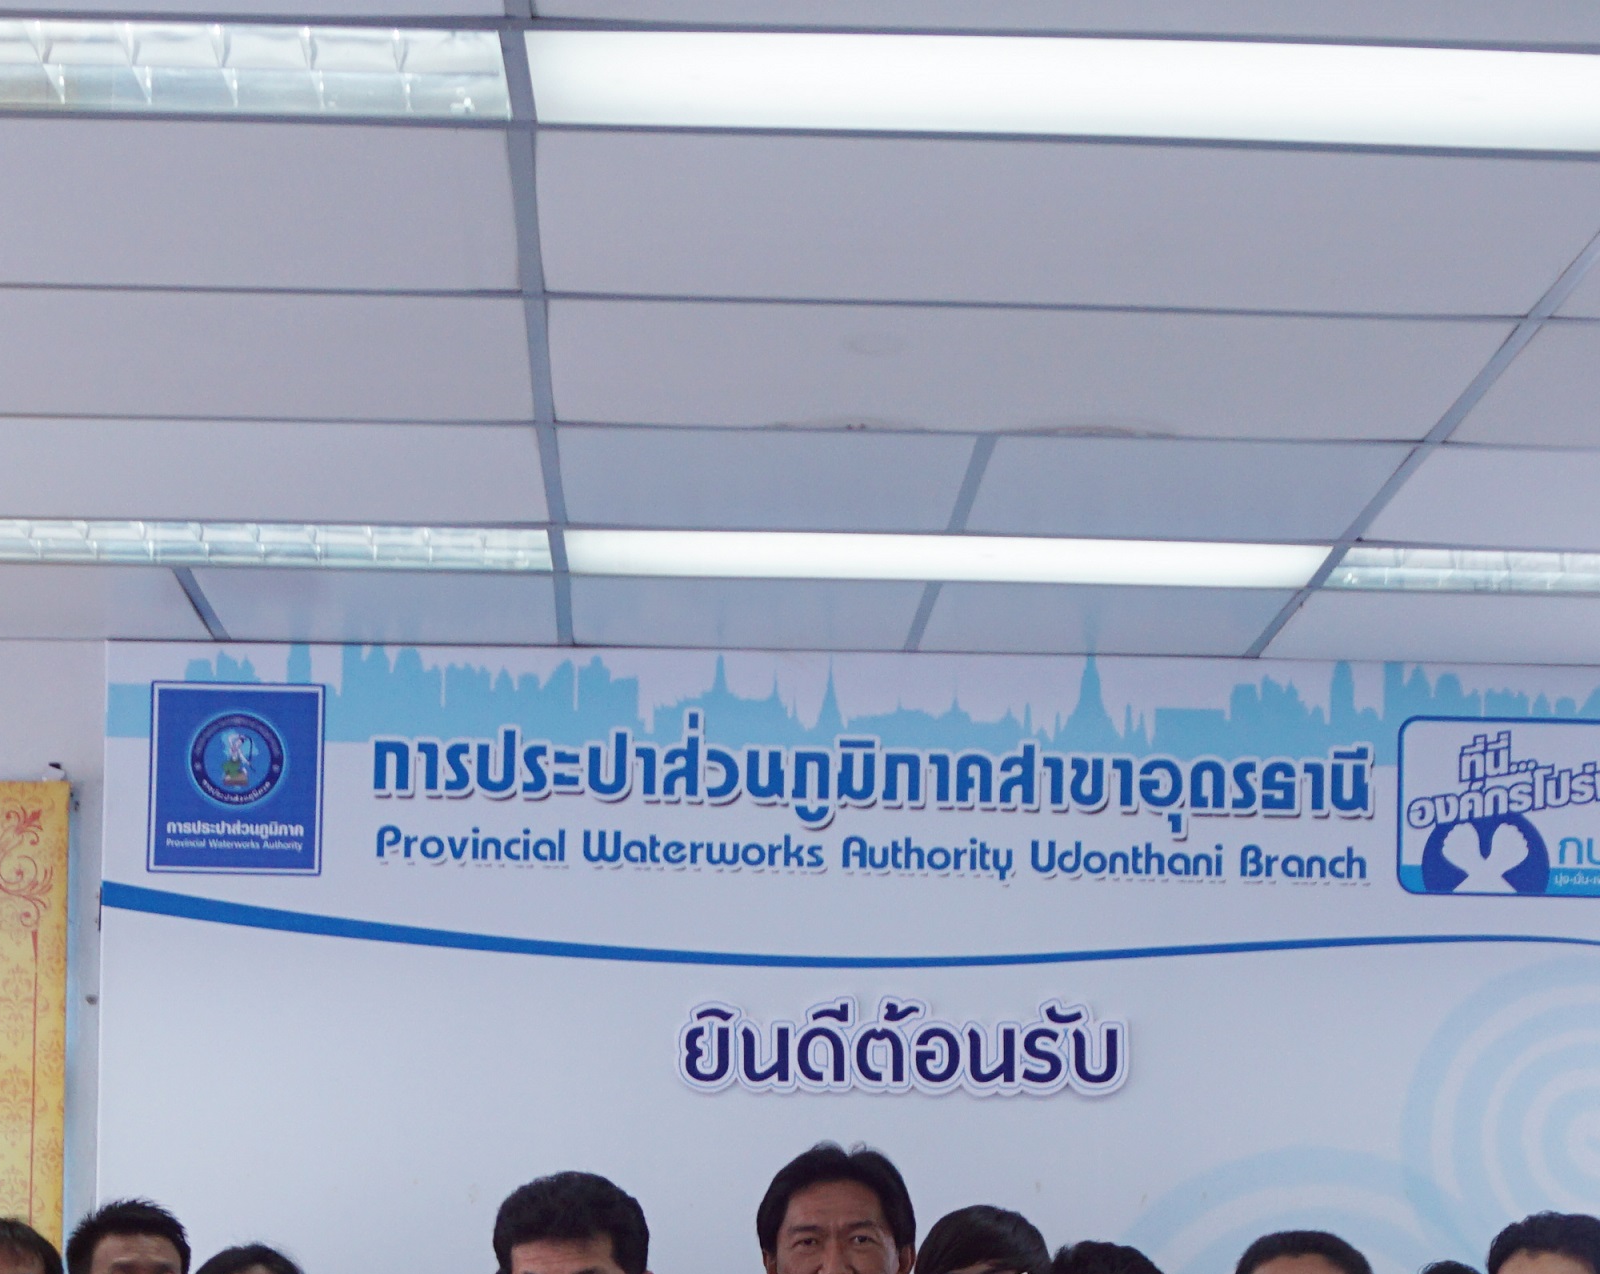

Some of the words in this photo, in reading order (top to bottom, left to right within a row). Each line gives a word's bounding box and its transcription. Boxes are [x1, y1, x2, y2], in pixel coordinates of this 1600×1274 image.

[373, 712, 1369, 832] การประปาส่วนภูมิภาคสาขาอุดรธานี
[166, 820, 304, 839] การประปาส่วนภูมิภาค
[166, 838, 206, 848] Provincial
[209, 839, 260, 849] Waterworks
[263, 840, 302, 852] Authority
[377, 825, 565, 862] Provincial
[583, 829, 824, 867] Waterworks
[842, 836, 1013, 880] Authority
[1031, 839, 1223, 877] Udonthani
[1240, 845, 1367, 879] Branch
[685, 1003, 1118, 1084] ยินดีต้อนรับ
